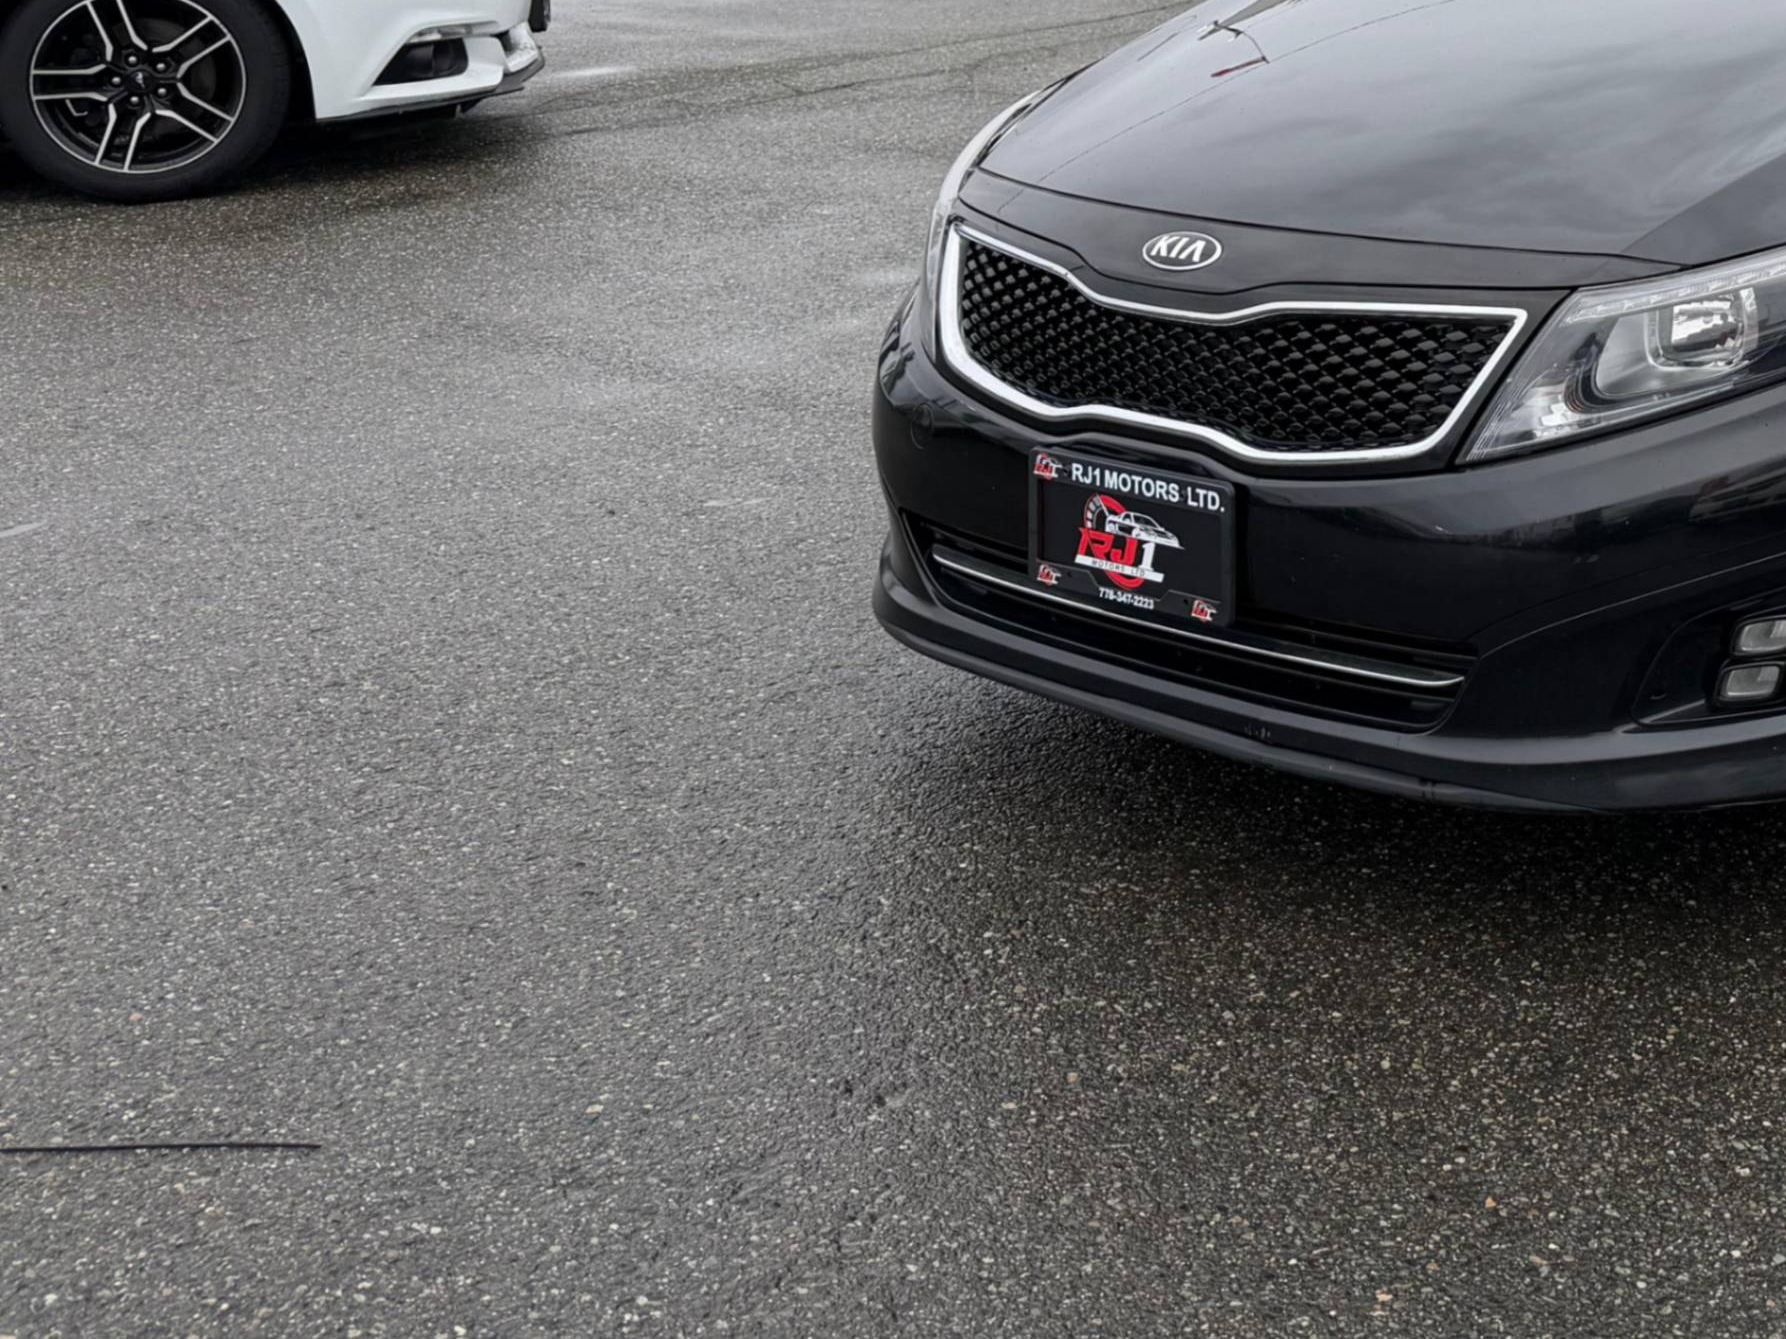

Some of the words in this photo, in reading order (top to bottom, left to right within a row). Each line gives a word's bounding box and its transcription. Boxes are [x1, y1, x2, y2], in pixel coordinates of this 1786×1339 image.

[1149, 235, 1207, 263] KIA
[1071, 462, 1101, 487] RJ1
[1103, 469, 1180, 503] MOTORS
[1187, 487, 1226, 512] LTD.
[1078, 527, 1157, 571] RJ1
[1091, 560, 1126, 573] MOTORS
